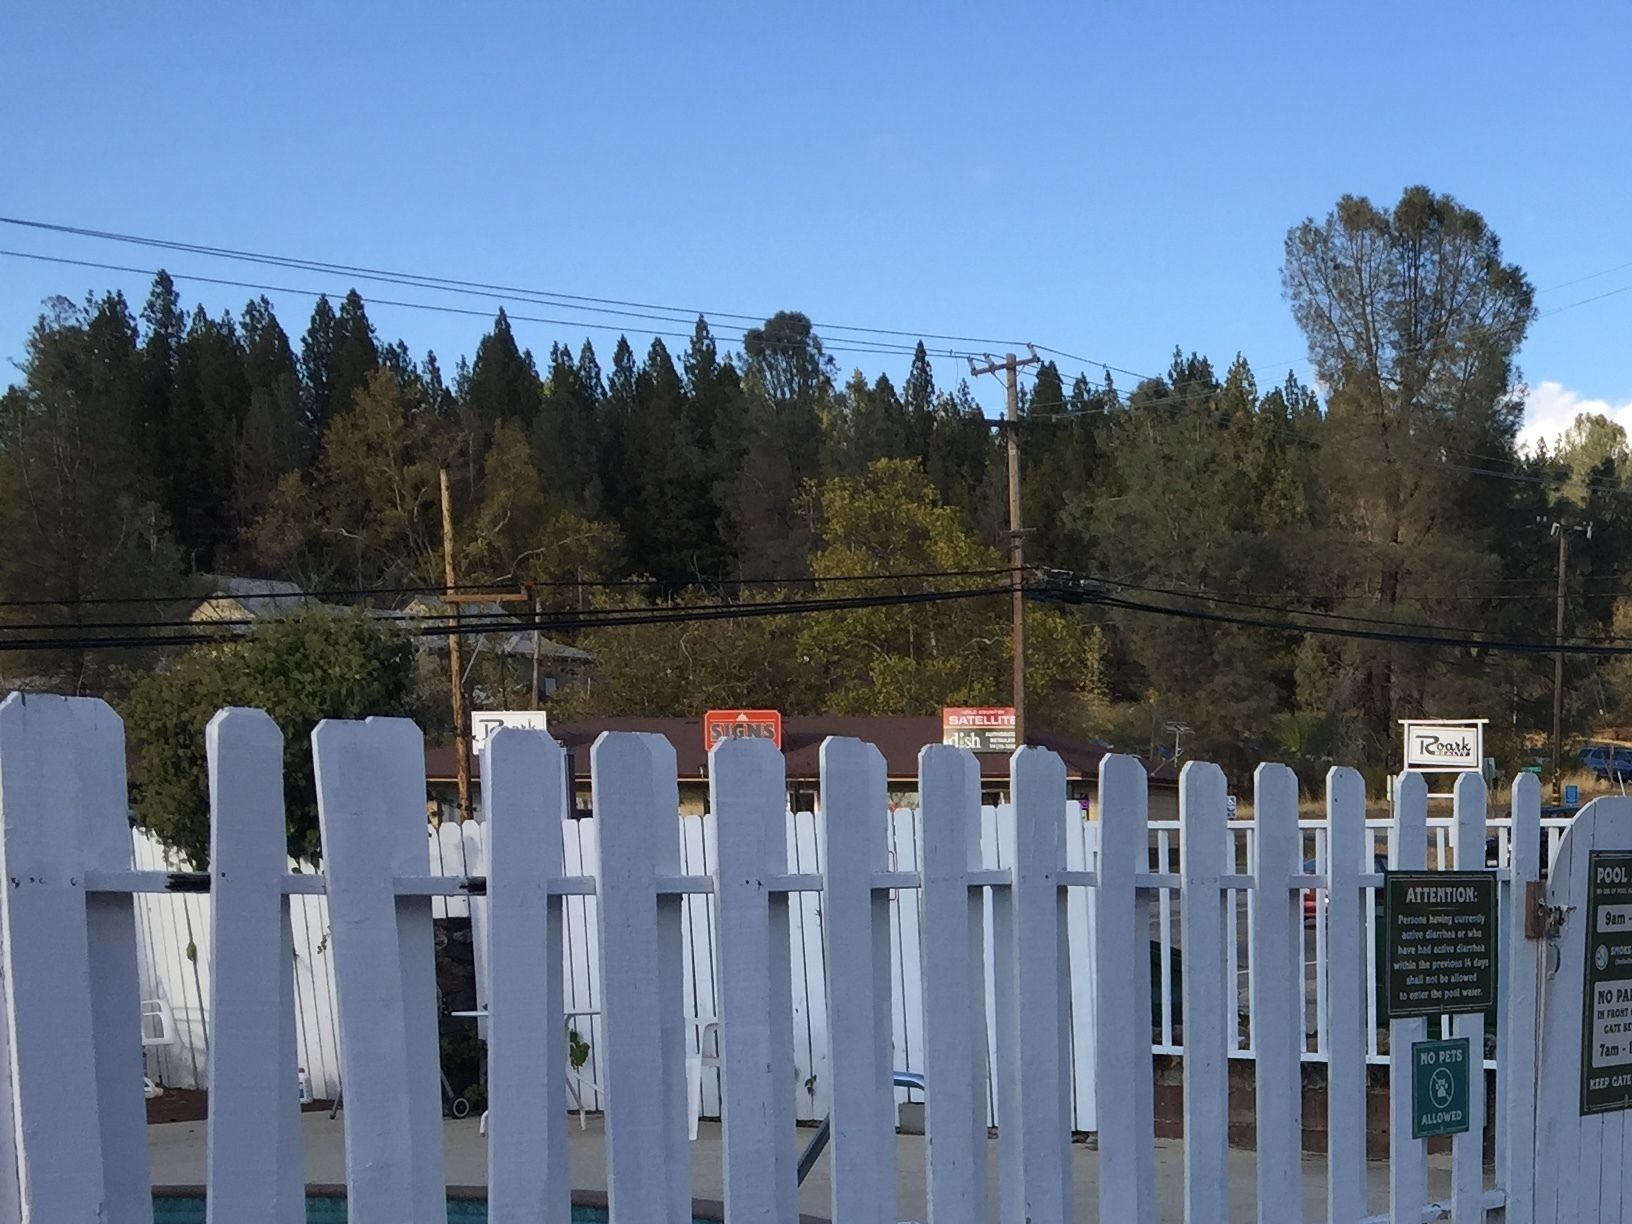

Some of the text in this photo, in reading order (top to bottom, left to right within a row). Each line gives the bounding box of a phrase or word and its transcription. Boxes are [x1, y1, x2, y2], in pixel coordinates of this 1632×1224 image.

[948, 715, 1015, 725] SATELLITE
[711, 722, 776, 740] SIGNS
[950, 732, 981, 749] dish
[1416, 735, 1471, 755] Roark
[1597, 866, 1628, 884] POOL
[1406, 887, 1478, 903] ATTENTION:
[1398, 913, 1485, 925] Persons having currently
[1605, 911, 1625, 926] 9am
[1402, 930, 1423, 940] active
[1426, 929, 1455, 939] diarrhea
[1467, 928, 1482, 938] who
[1398, 943, 1485, 955] have had active diarrhea
[1393, 960, 1417, 970] within
[1418, 960, 1430, 969] the
[1432, 959, 1463, 970] previous
[1473, 958, 1489, 969] days
[1406, 972, 1477, 985] shall not be allowed
[1400, 991, 1408, 1000] to
[1409, 991, 1429, 1000] enter
[1430, 989, 1442, 999] the
[1444, 988, 1460, 999] pool
[1597, 989, 1613, 1004] NO
[1597, 1010, 1605, 1019] IN
[1607, 1007, 1629, 1018] FRONT
[1604, 1023, 1621, 1034] GATE
[1420, 1049, 1463, 1065] NO PETS
[1600, 1043, 1619, 1057] 7am
[1589, 1076, 1610, 1090] KEEP
[1611, 1074, 1632, 1087] GATE
[1421, 1110, 1463, 1125] ALLOWED
